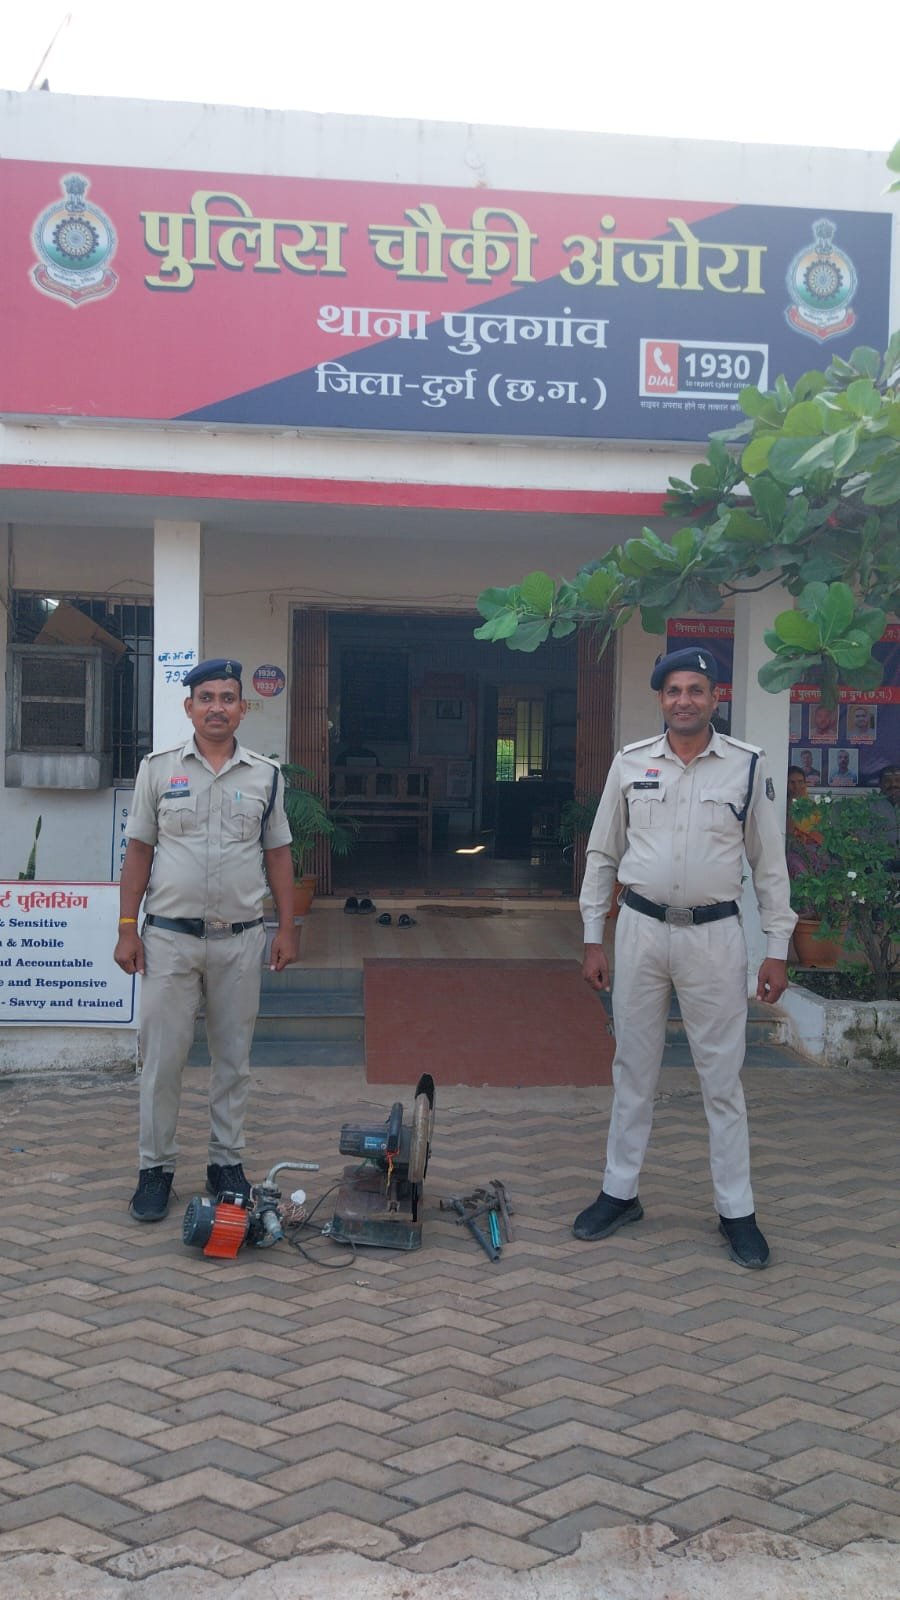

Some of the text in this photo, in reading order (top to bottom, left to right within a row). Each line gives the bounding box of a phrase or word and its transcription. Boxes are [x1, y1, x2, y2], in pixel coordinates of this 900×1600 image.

[140, 190, 768, 294] पुलिस चौकी अंजोरा
[317, 304, 609, 355] थाना पुलगांव
[684, 353, 751, 380] 1930
[315, 362, 608, 411] जिला-दुर्ग (छ.ग.)
[648, 375, 675, 387] DIAL
[694, 380, 714, 388] report
[715, 381, 732, 390] cyber
[17, 891, 89, 913] पुलिसिंग
[9, 918, 67, 928] Sensitive
[7, 939, 17, 948] &
[21, 938, 64, 948] Mobile
[16, 958, 94, 968] Accountable
[8, 978, 32, 987] and
[36, 978, 108, 989] Responsive
[9, 998, 46, 1009] Savvy
[50, 998, 73, 1007] and
[78, 998, 124, 1008] trained
